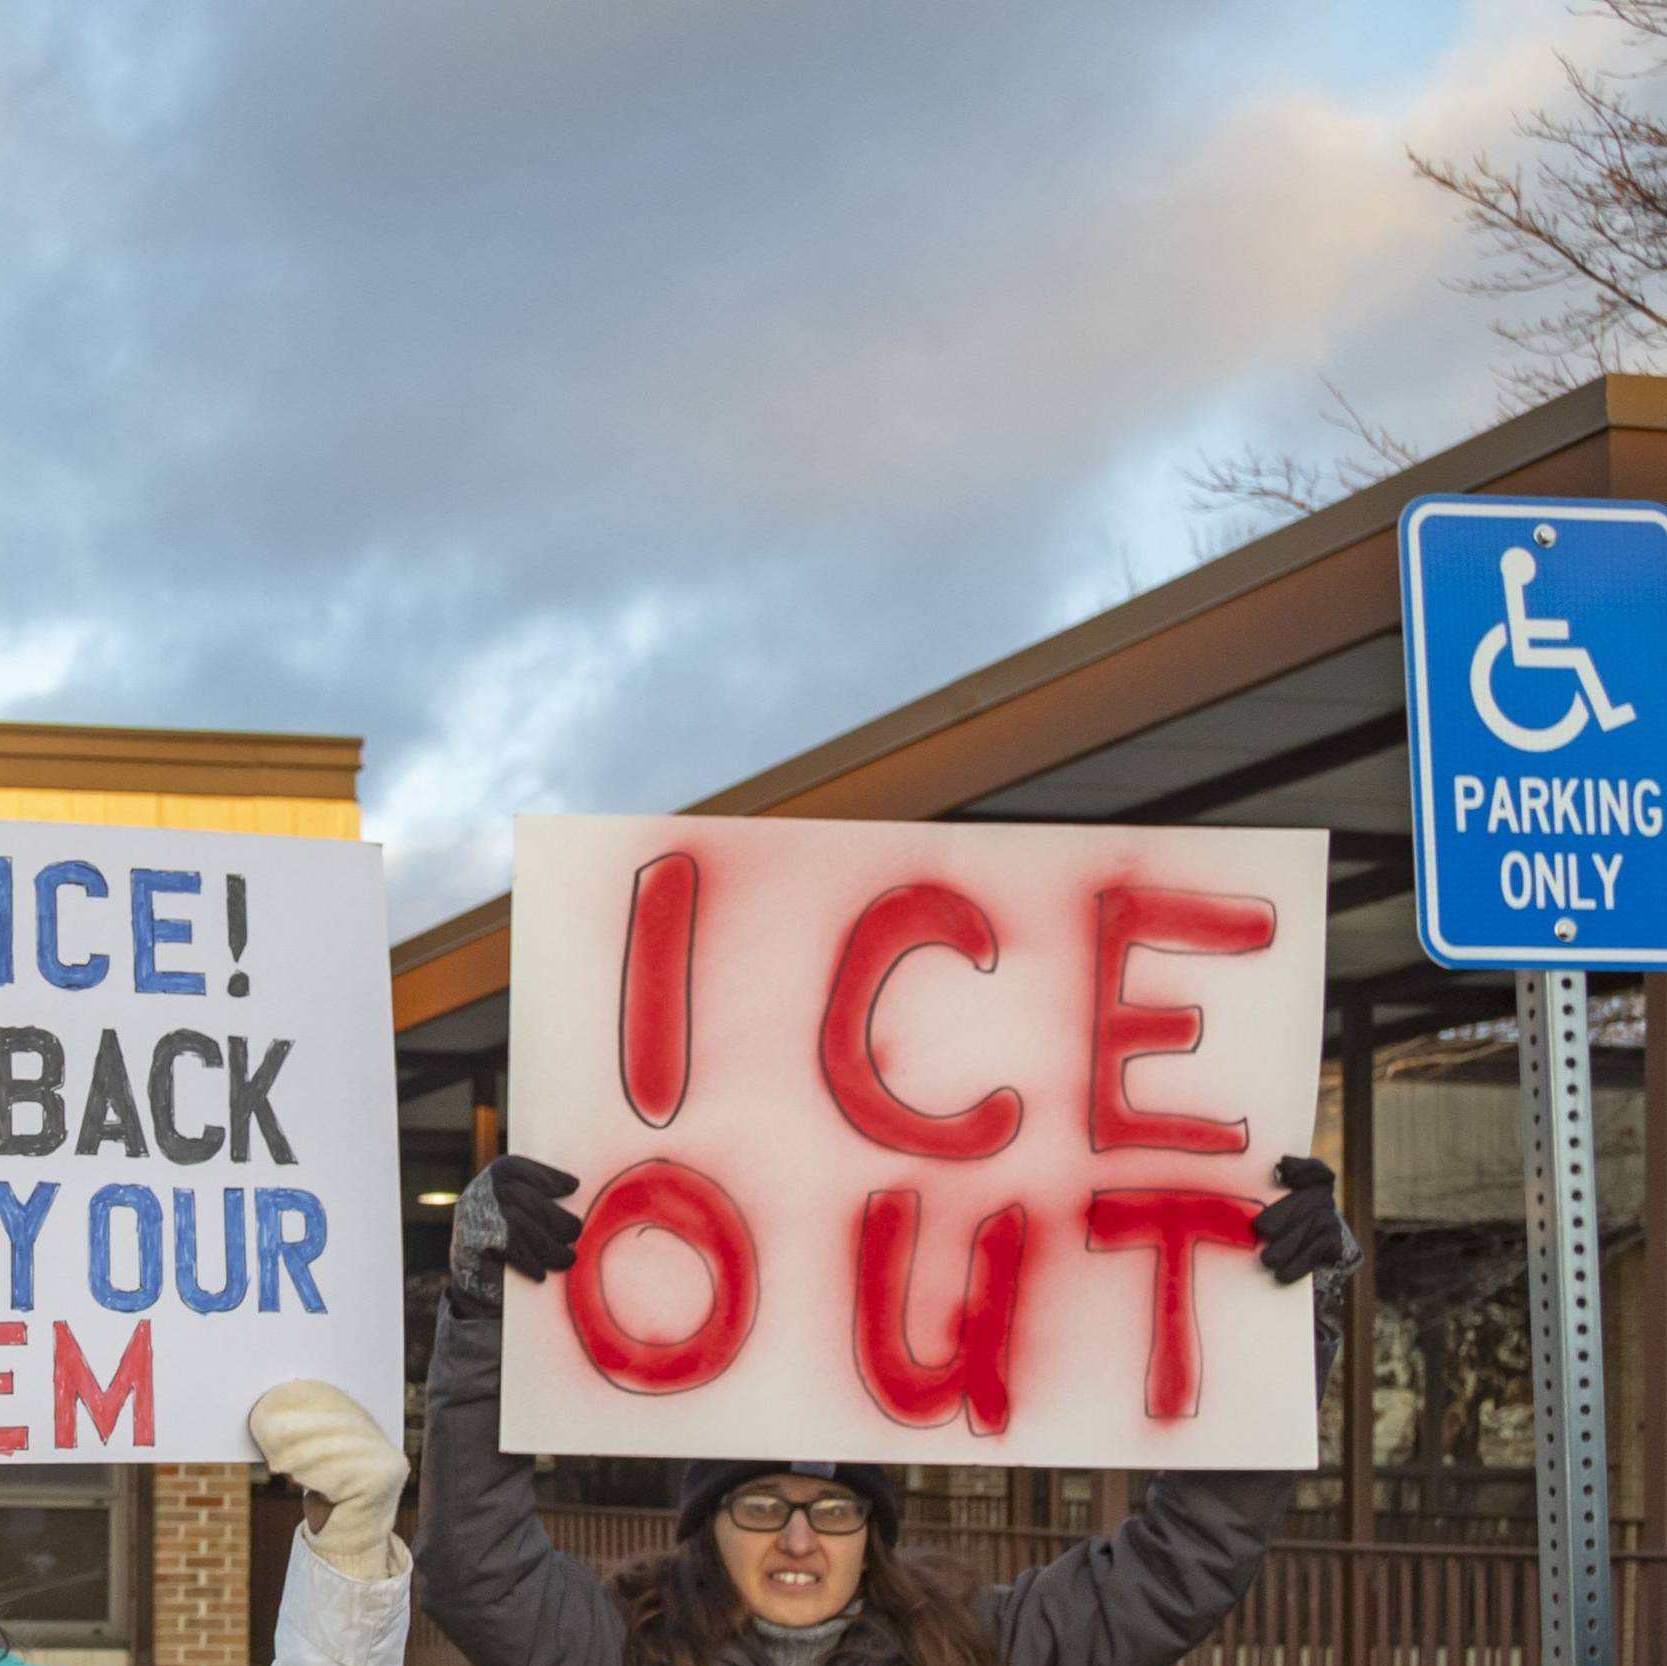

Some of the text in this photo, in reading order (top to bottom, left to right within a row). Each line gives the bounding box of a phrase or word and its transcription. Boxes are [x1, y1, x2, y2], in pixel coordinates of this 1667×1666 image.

[1453, 775, 1664, 838] PARKING
[1500, 851, 1624, 911] ONLY
[619, 851, 1277, 1161] ICE
[565, 1158, 1268, 1437] OUT
